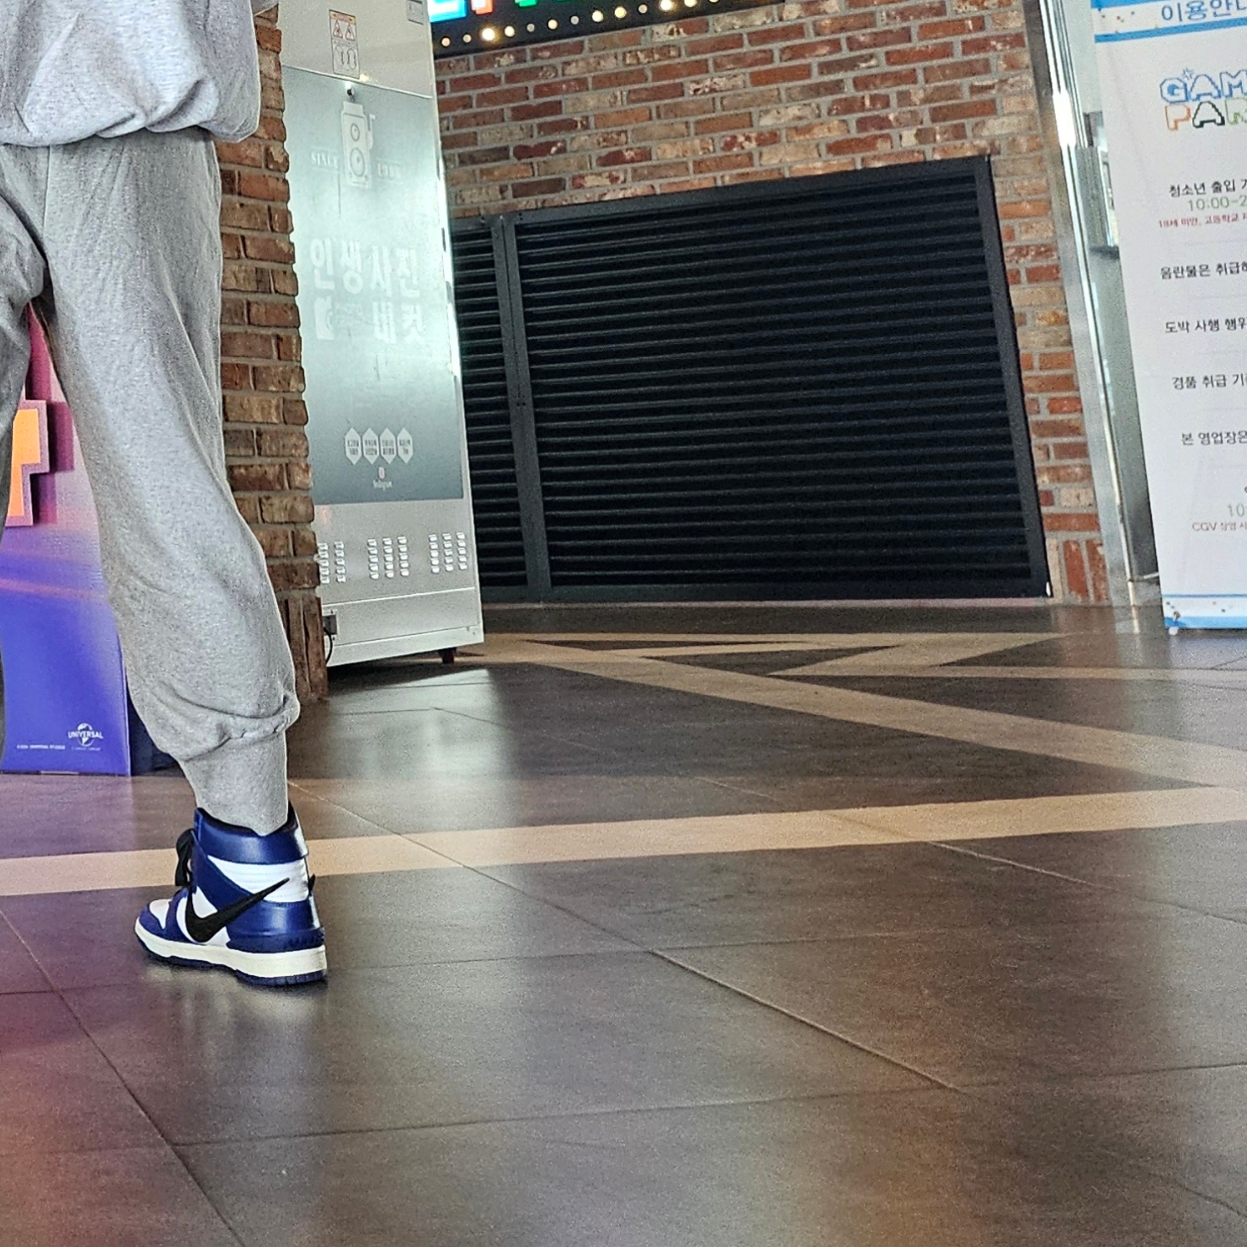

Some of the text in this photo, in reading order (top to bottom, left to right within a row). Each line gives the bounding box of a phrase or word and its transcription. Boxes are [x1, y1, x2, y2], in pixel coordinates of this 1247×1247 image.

[1169, 184, 1206, 198] 청소년
[1211, 179, 1236, 194] 출입
[1160, 264, 1211, 280] 음란물은
[1165, 321, 1190, 333] 도박
[1194, 318, 1220, 332] 사행
[1202, 374, 1226, 388] 취급
[1232, 372, 1247, 387] 기
[1181, 432, 1193, 445] 본
[1192, 522, 1217, 531] CGV
[67, 731, 104, 739] UNIVERSAL
